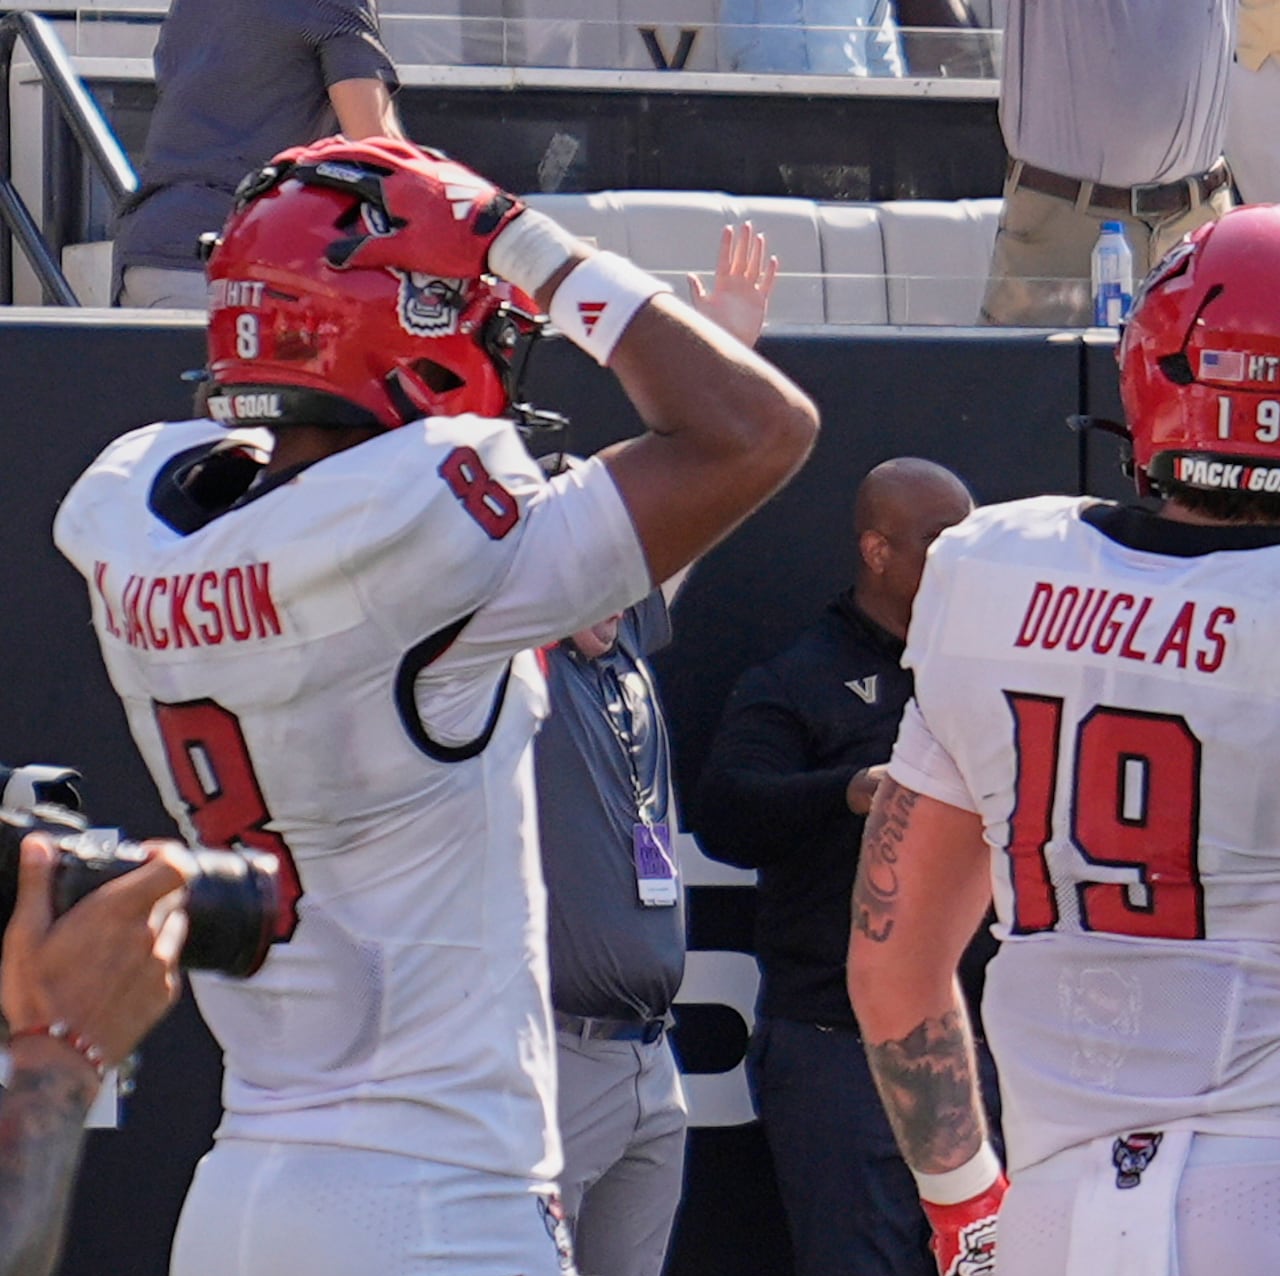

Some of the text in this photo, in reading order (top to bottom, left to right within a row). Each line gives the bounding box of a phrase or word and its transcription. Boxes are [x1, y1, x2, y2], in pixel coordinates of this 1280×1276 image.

[226, 281, 265, 308] HTT
[235, 313, 258, 360] 8
[438, 446, 520, 540] 8
[1014, 577, 1236, 674] DOUGLAS
[843, 674, 878, 704] V
[1002, 689, 1206, 940] 19
